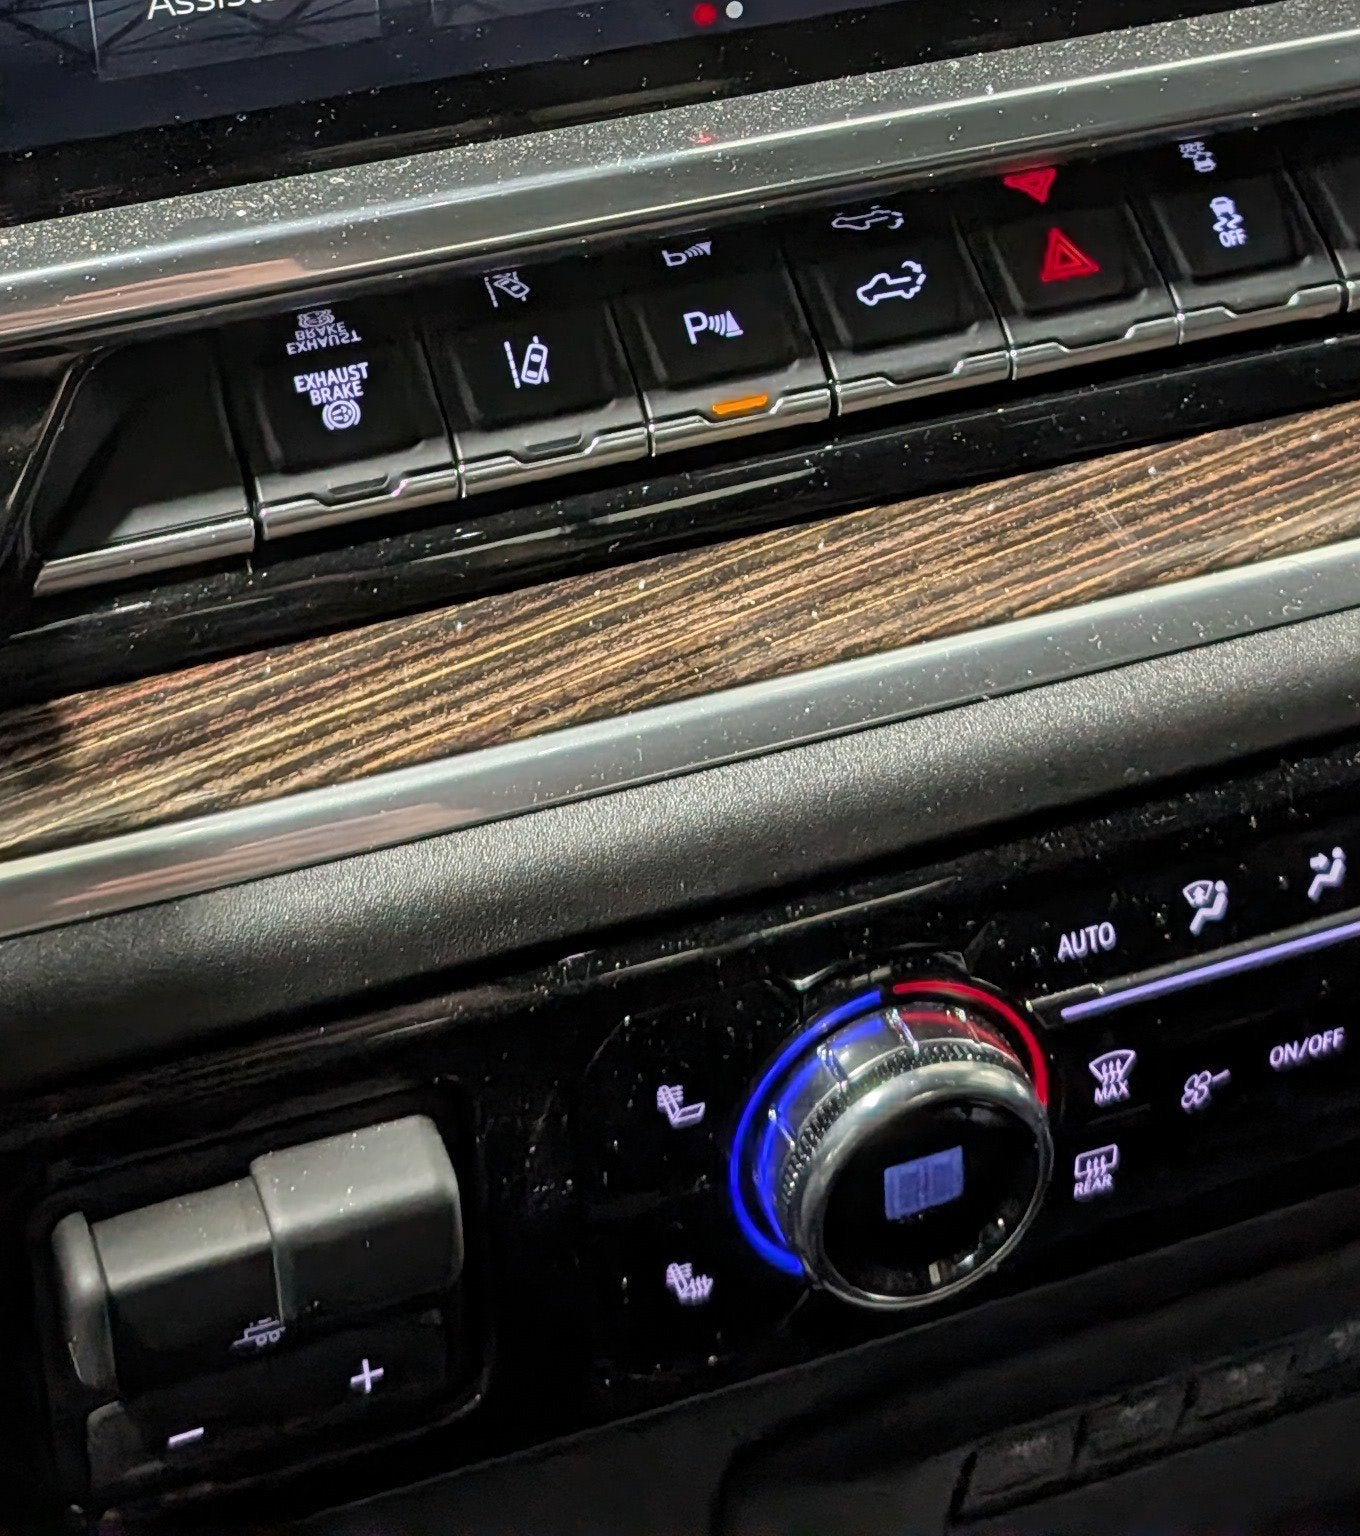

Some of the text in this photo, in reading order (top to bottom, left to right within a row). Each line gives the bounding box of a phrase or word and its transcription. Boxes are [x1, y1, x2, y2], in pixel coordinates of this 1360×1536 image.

[1219, 227, 1247, 248] OFF
[682, 311, 709, 345] P
[293, 361, 369, 393] EXHAUST
[309, 380, 365, 407] BRAKE
[1057, 921, 1116, 960] AUTO
[1269, 1027, 1344, 1068] ON/OFF
[1093, 1079, 1129, 1104] MAX
[1073, 1173, 1113, 1198] REAR
